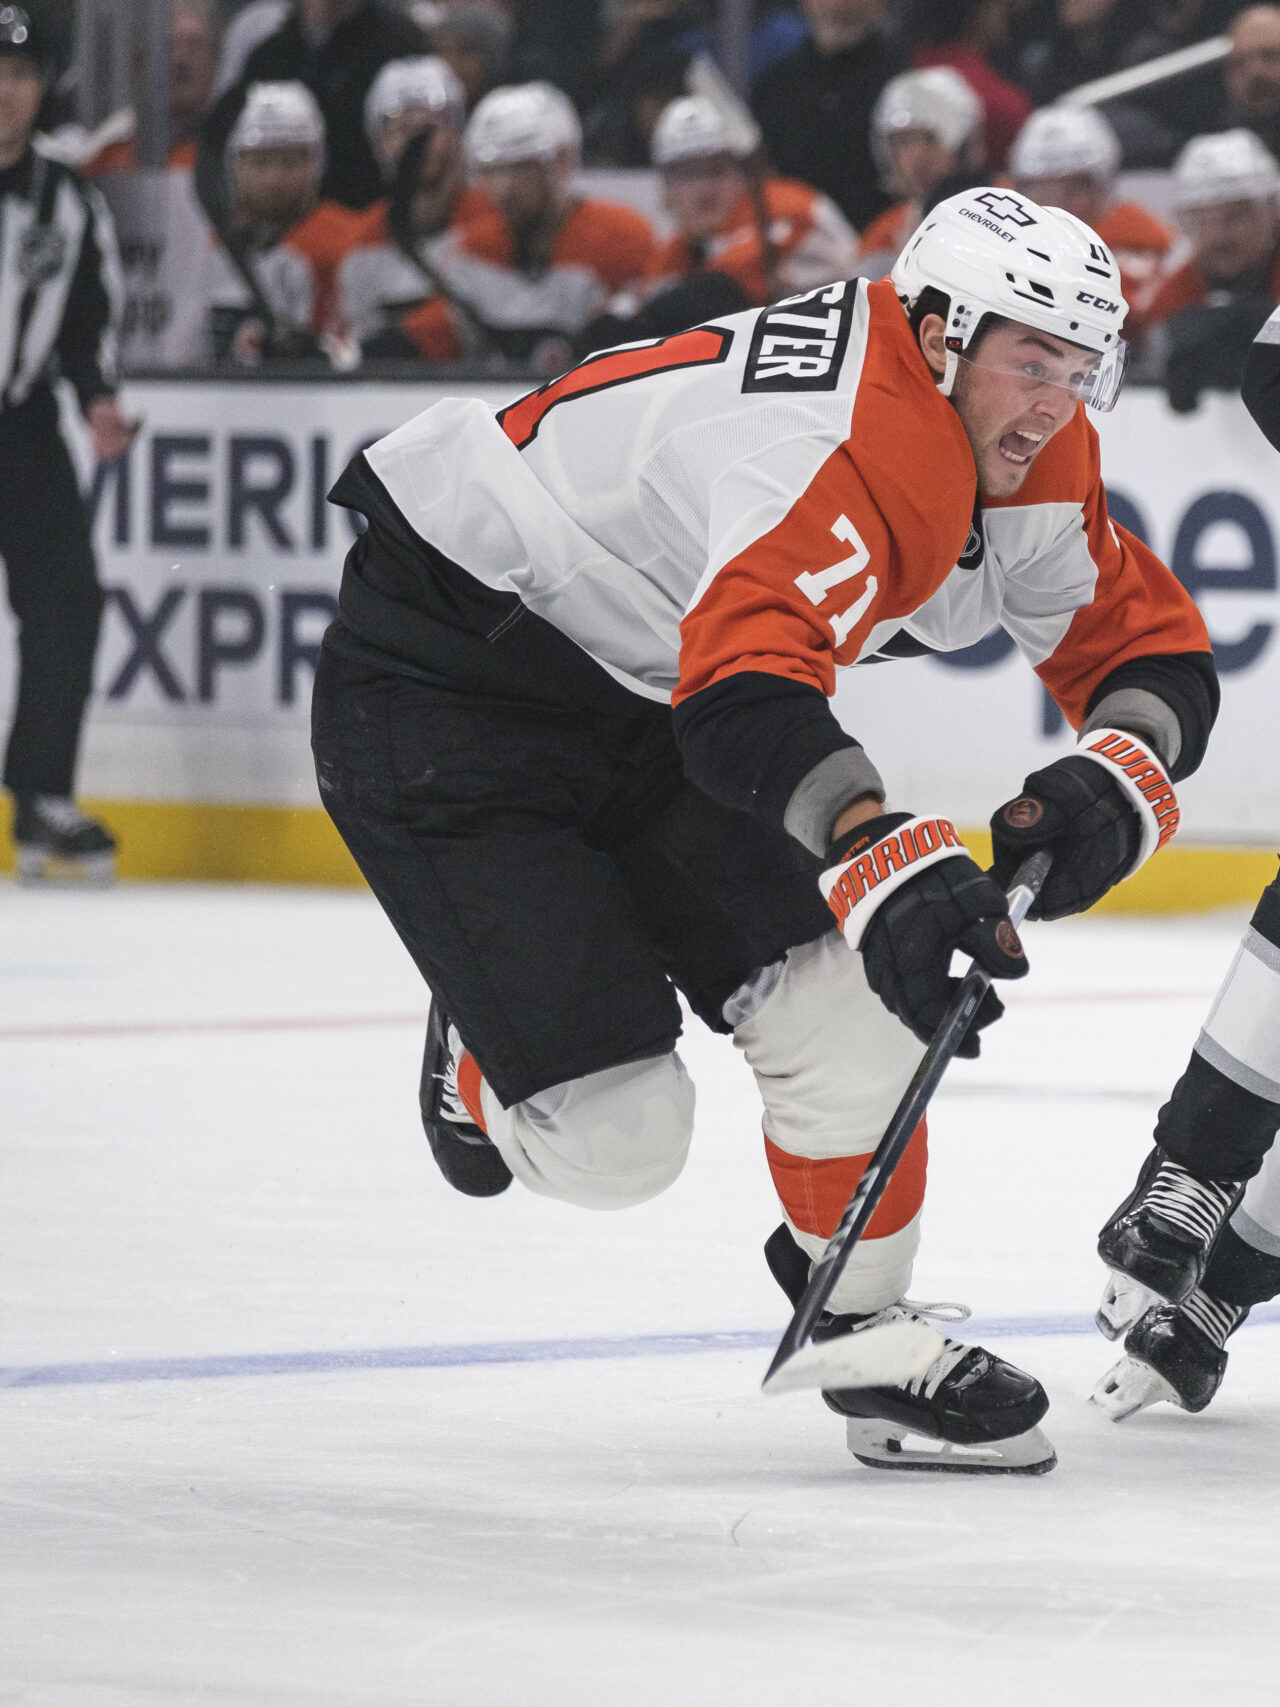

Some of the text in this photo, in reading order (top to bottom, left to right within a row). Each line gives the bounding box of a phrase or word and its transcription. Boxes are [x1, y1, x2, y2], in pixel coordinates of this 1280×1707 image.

[959, 208, 1017, 243] CHEVROLET
[1076, 290, 1119, 314] CCM
[794, 513, 878, 648] 71
